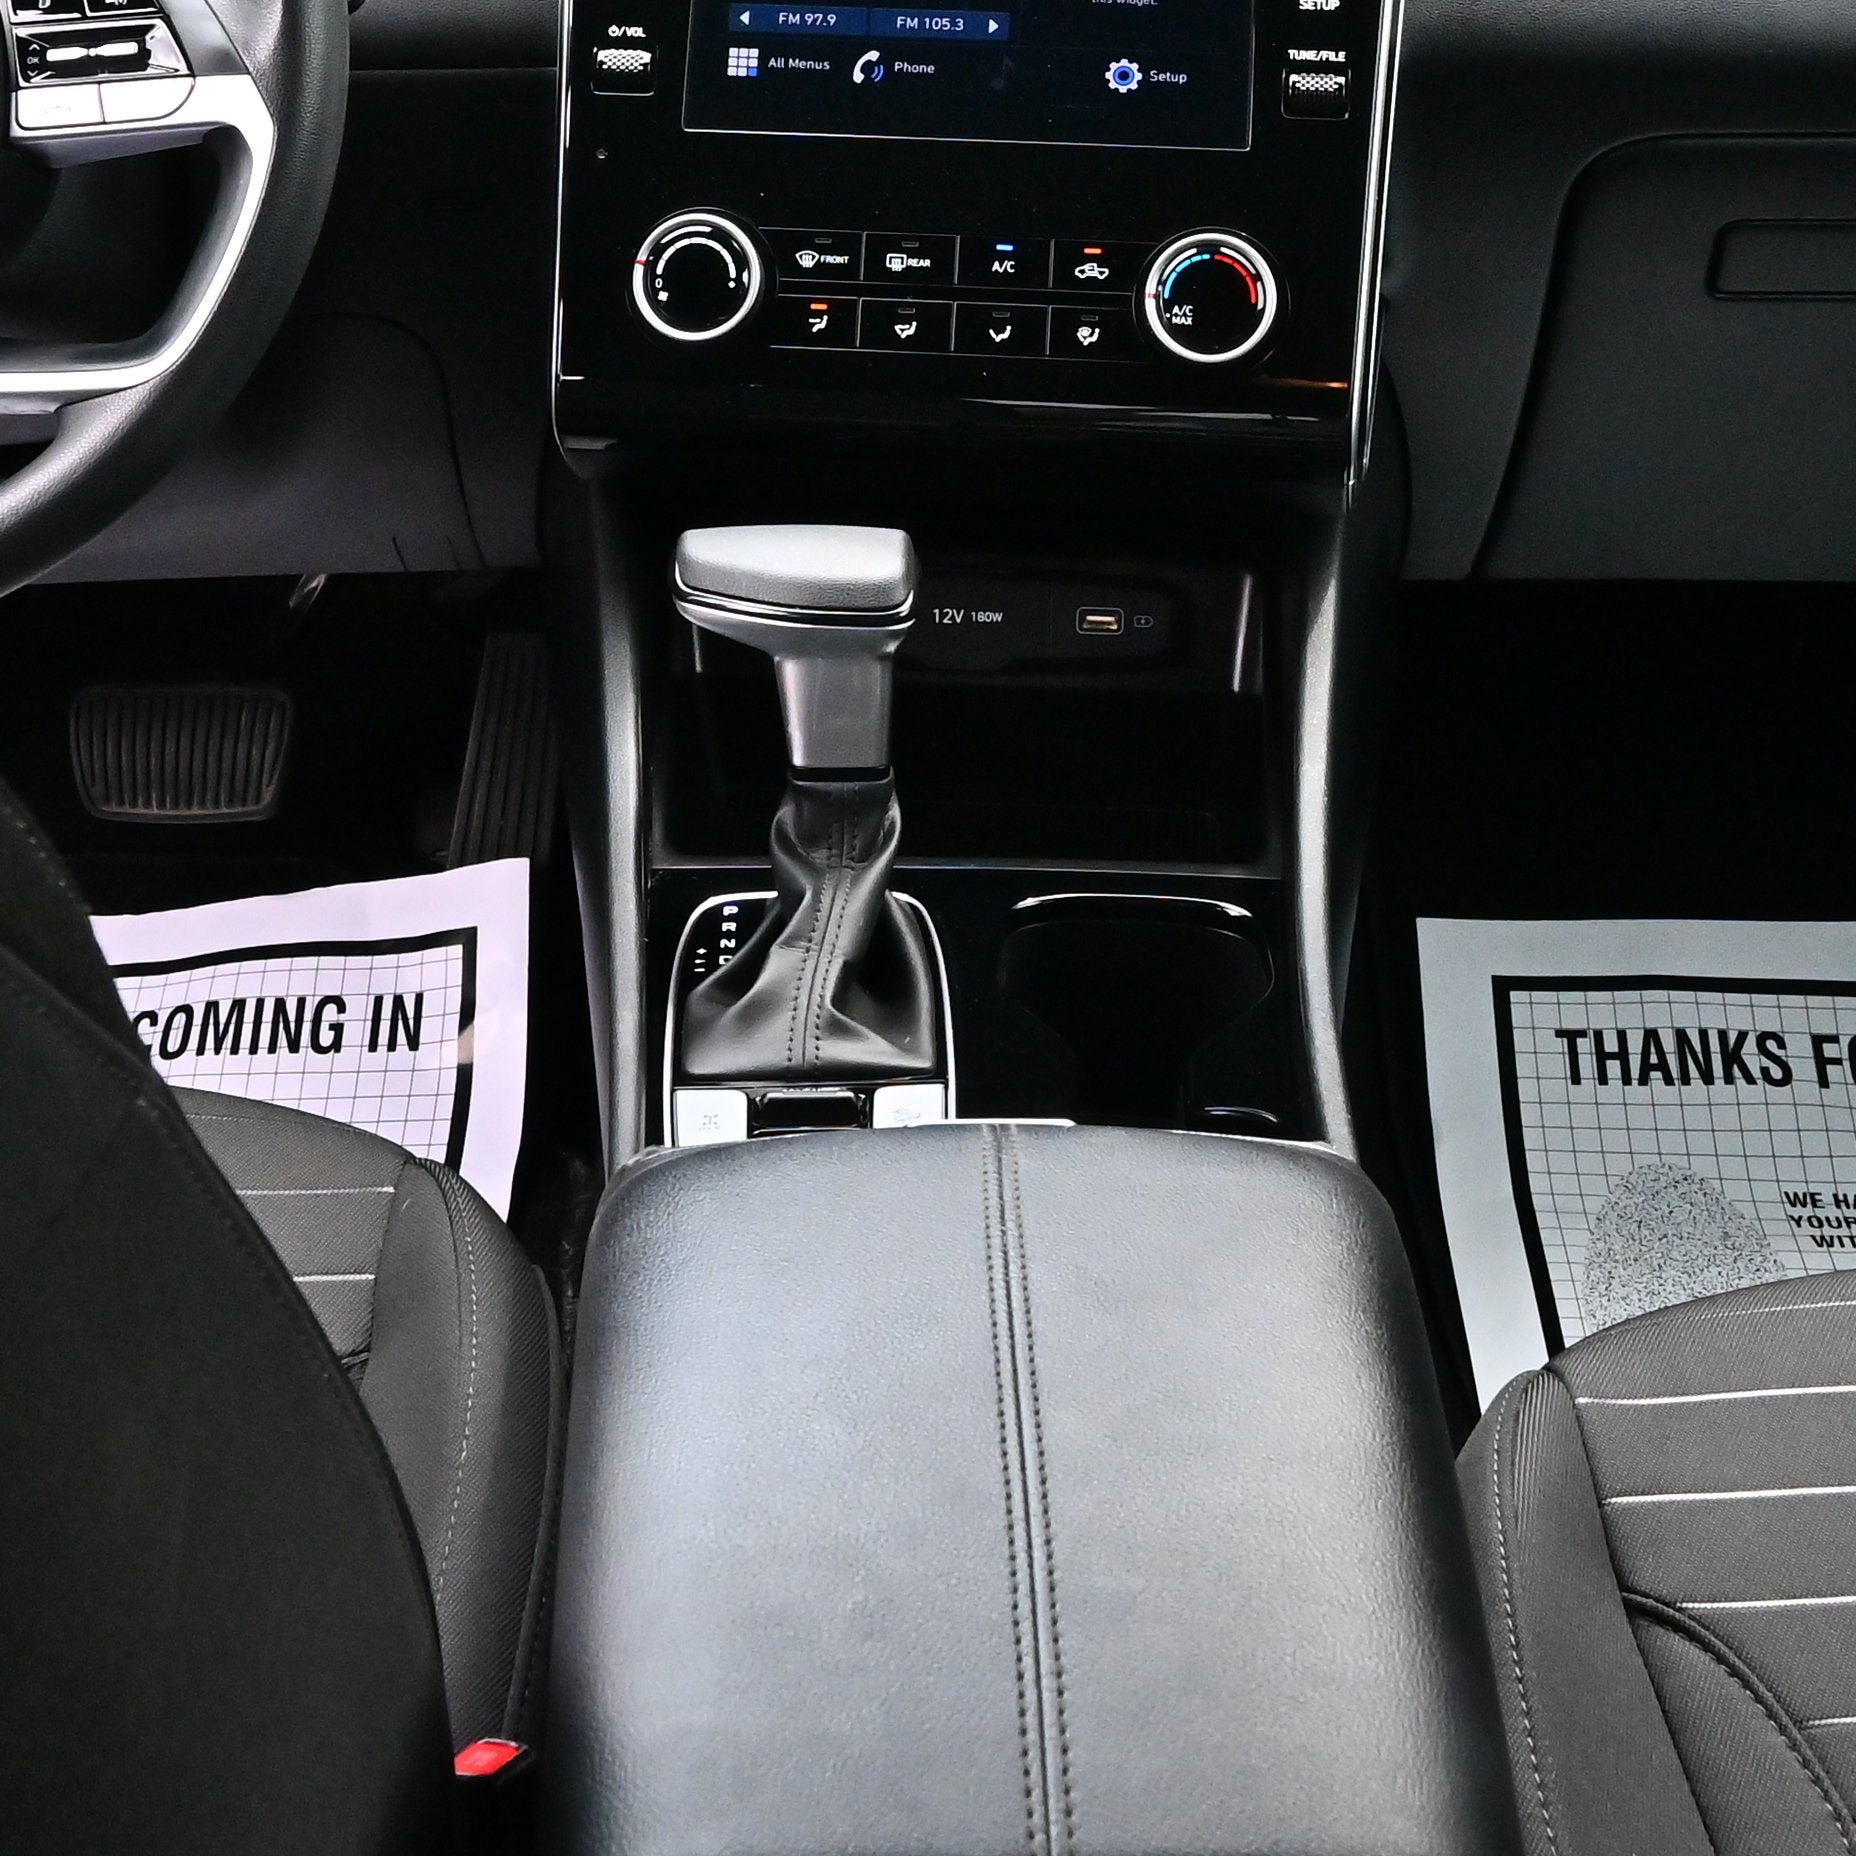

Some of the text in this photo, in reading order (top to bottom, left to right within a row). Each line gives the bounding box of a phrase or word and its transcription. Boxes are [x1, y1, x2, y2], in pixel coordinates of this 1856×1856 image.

[778, 12, 837, 27] FM 97.9
[896, 16, 965, 32] FM 105.3
[27, 56, 40, 65] OK
[1287, 48, 1347, 62] TUNE/FILE
[767, 57, 831, 71] All Menus
[894, 60, 936, 75] Phone
[1149, 69, 1188, 85] Setup
[821, 253, 850, 265] FRONT
[908, 256, 931, 268] REAR
[992, 259, 1016, 274] A/C
[1172, 305, 1194, 317] A/C
[1172, 315, 1194, 326] MAX
[932, 608, 965, 624] 12V
[722, 905, 740, 916] P
[721, 921, 737, 932] R
[719, 938, 736, 949] N
[133, 992, 424, 1061] COMING IN
[1556, 1028, 1792, 1089] THANKS
[1784, 1190, 1824, 1209] WE
